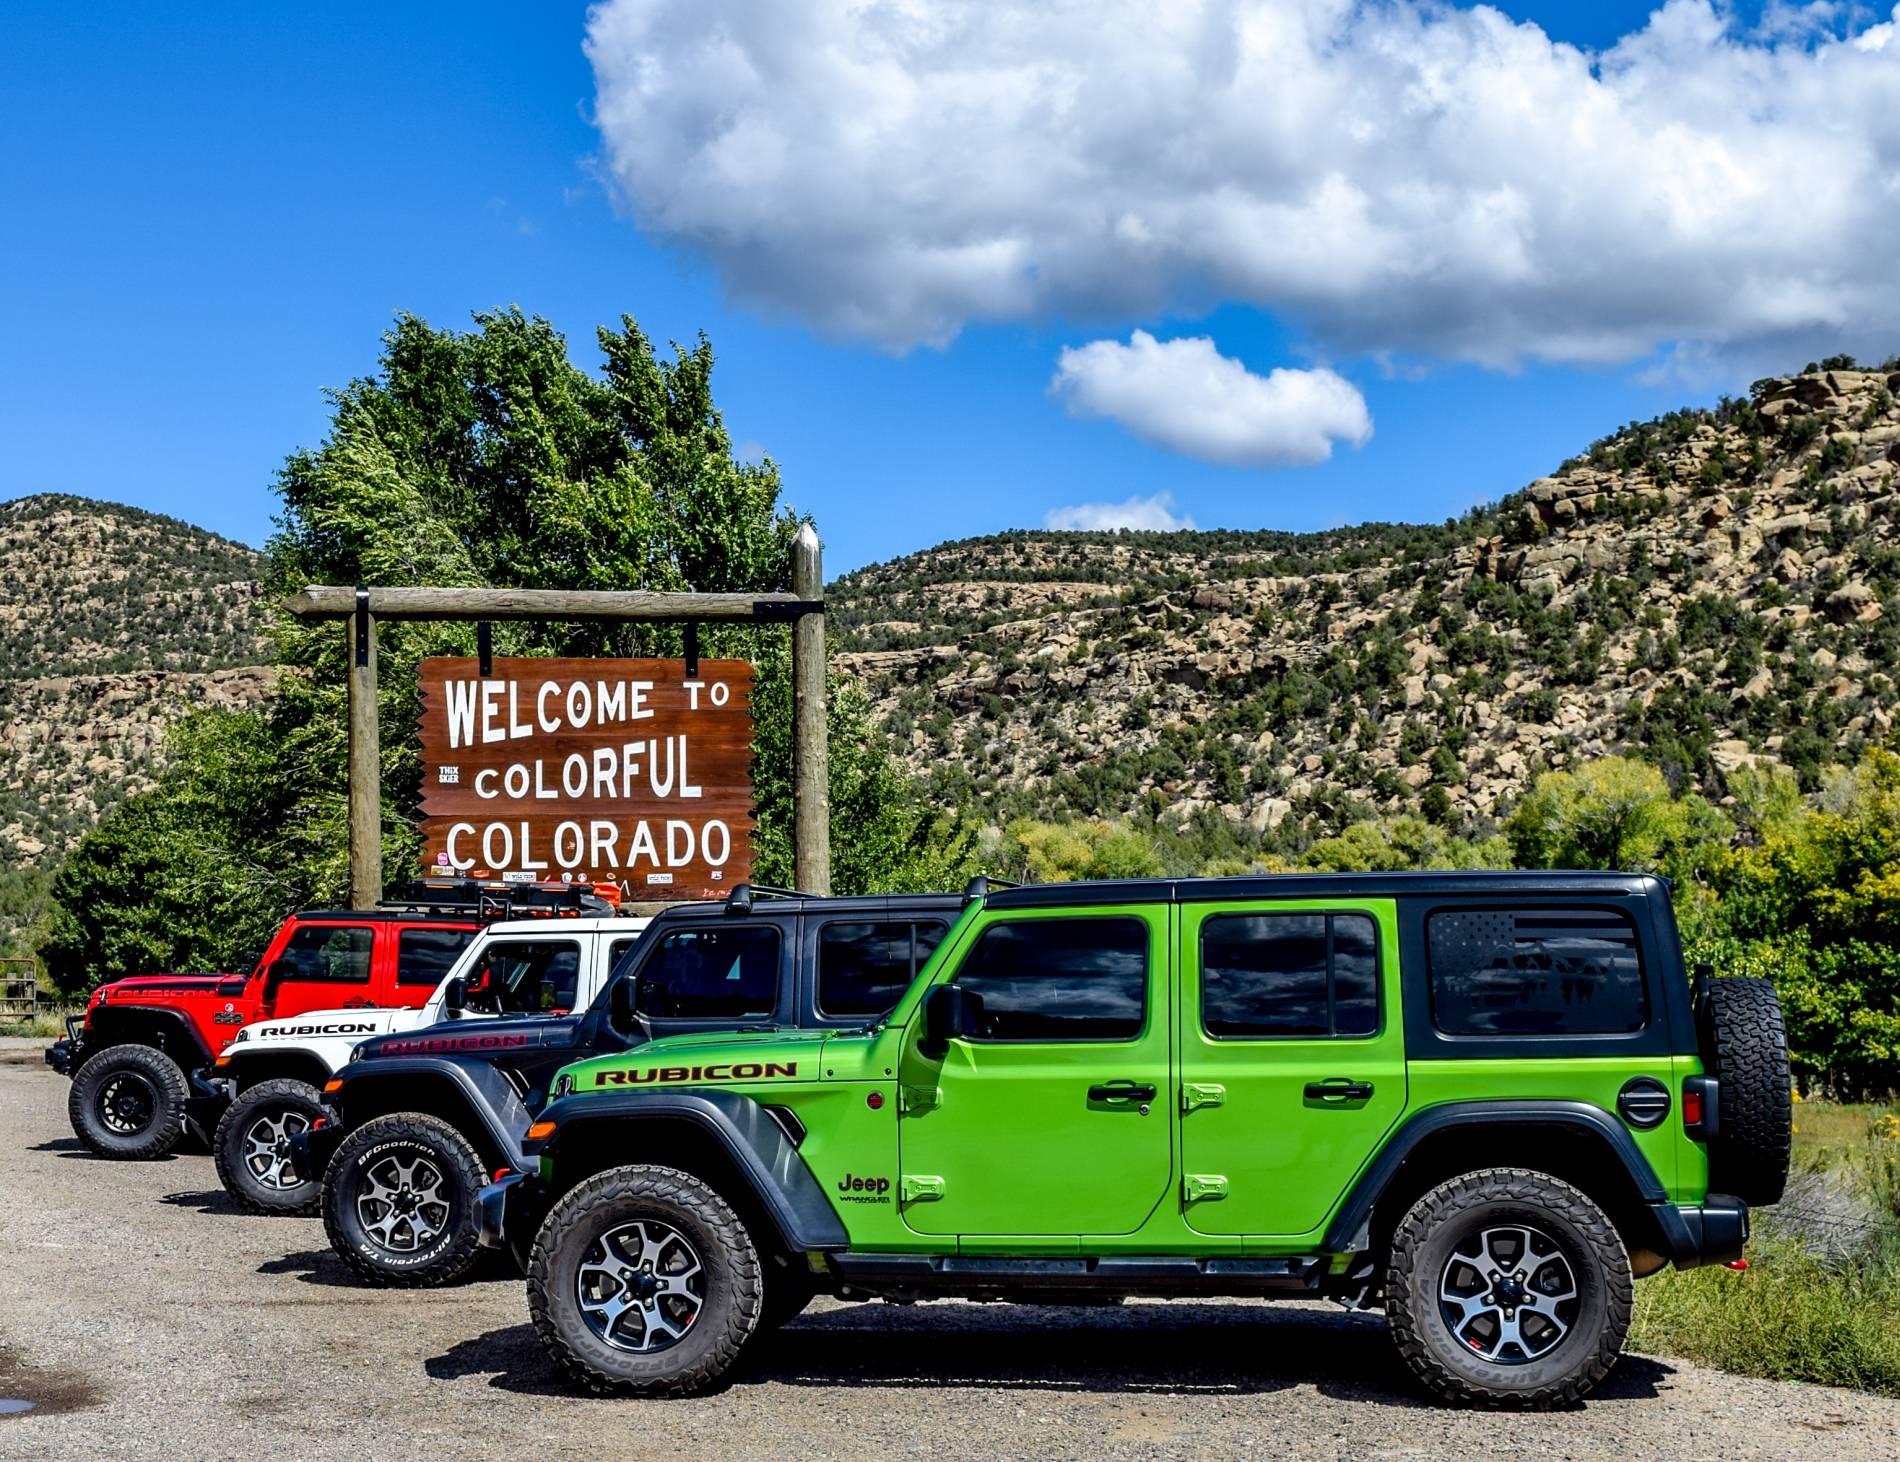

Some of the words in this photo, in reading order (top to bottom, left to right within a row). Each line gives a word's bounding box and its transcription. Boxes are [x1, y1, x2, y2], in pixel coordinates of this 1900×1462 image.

[445, 680, 654, 749] WELCOME
[682, 681, 730, 711] TO
[474, 734, 702, 799] COLORFUL
[446, 819, 731, 871] COLORADO
[260, 1022, 376, 1038] RUBICON
[381, 1034, 528, 1055] RUBICON
[595, 1061, 798, 1086] RUBICON
[357, 1140, 436, 1167] BFGoodrich
[838, 1173, 890, 1195] Jeep
[383, 1233, 451, 1266] All-Terrain
